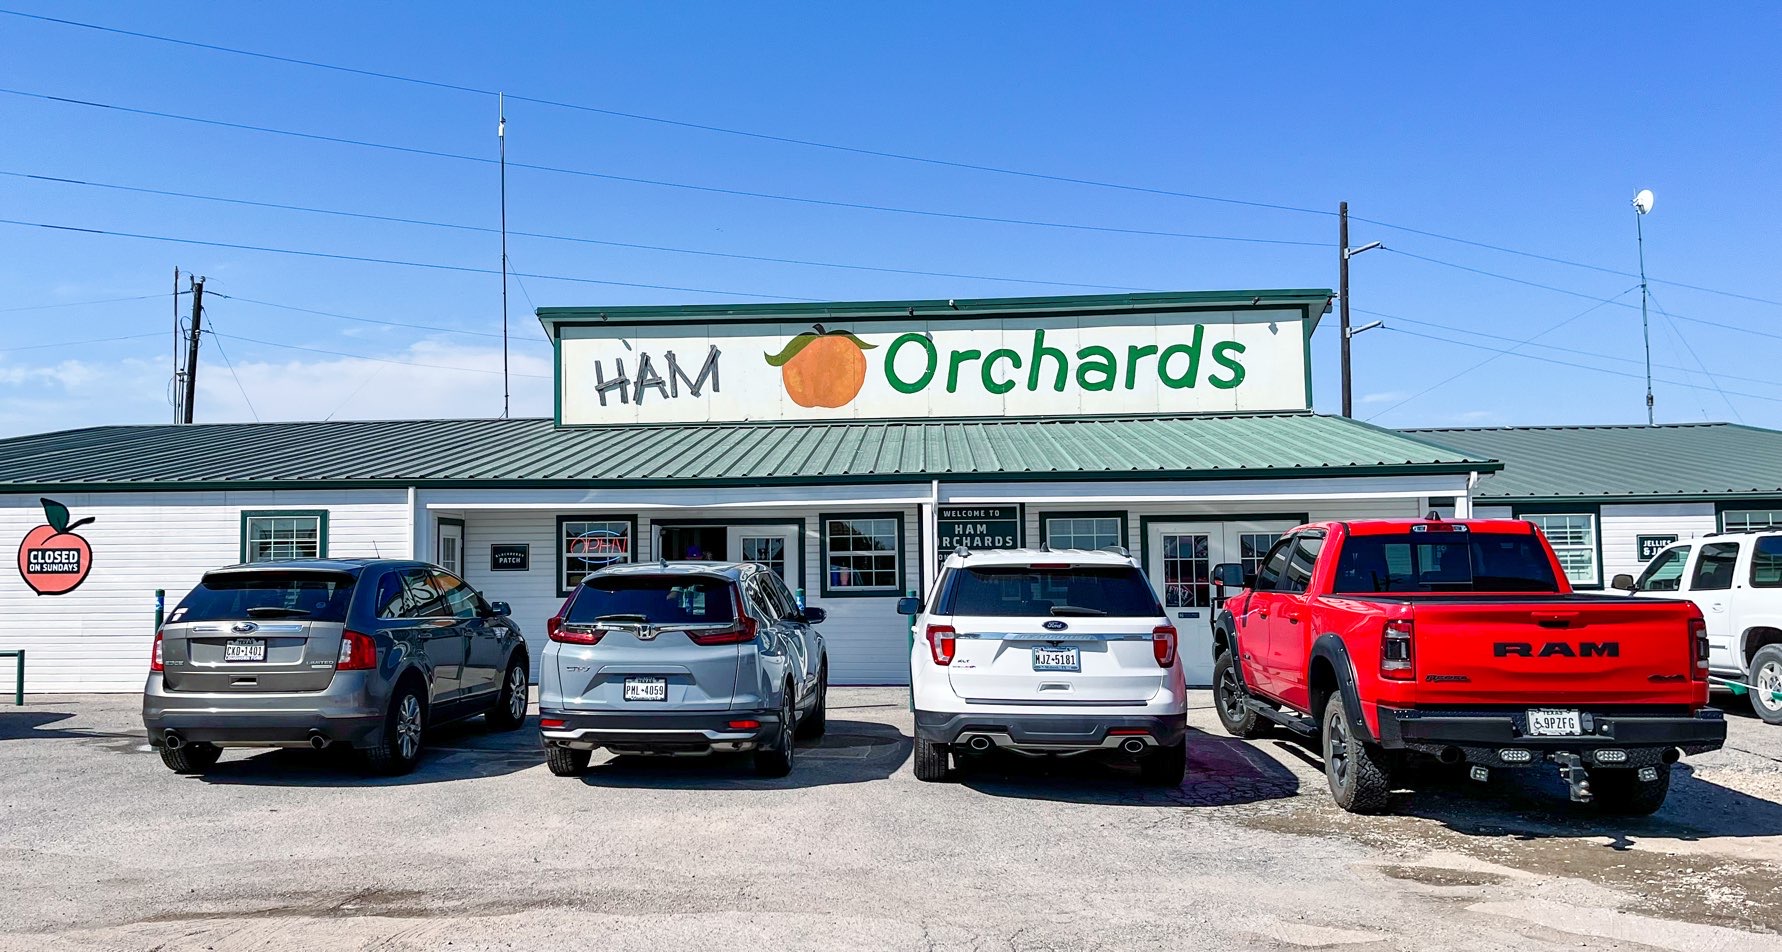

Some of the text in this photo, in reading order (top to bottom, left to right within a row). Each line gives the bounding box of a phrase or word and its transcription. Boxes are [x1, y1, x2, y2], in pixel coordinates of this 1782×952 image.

[594, 324, 1246, 406] HAM Orchards
[954, 524, 987, 535] HAM
[937, 536, 1013, 547] RCHARDS
[30, 551, 78, 563] CLOSED
[29, 563, 78, 572] ON SUNDAYS
[1493, 642, 1619, 657] RAM
[1543, 717, 1575, 729] 9PZFG
